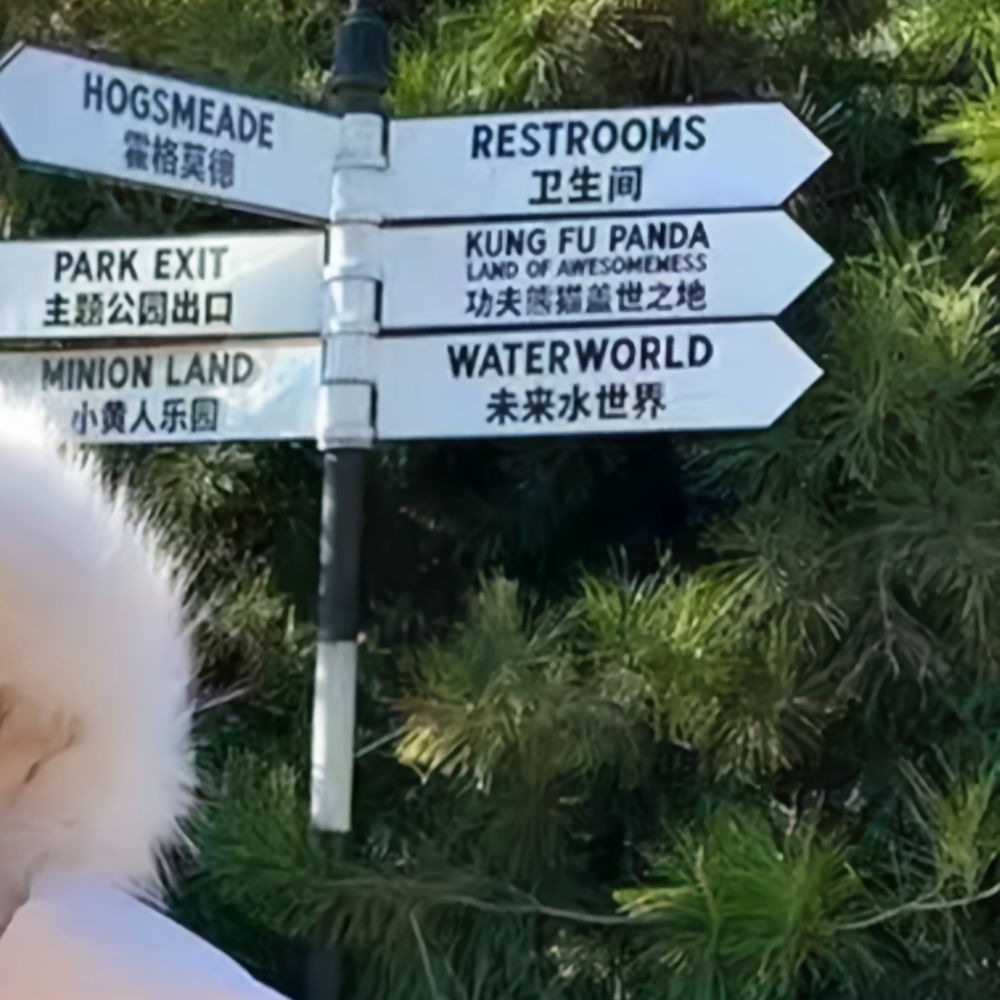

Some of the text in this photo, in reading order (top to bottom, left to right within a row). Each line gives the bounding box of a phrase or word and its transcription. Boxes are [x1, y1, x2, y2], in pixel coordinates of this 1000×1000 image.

[82, 71, 275, 150] HOGSMEADE
[470, 115, 706, 159] RESTROOMS
[528, 165, 643, 206] 卫生间
[466, 221, 710, 259] KUNG FU PANDA
[53, 246, 229, 283] PARK EXIT
[466, 253, 708, 282] LAND OF AWESOMENESS
[42, 290, 233, 328] 主题公园出口
[40, 351, 254, 391] MINION LAND
[446, 334, 714, 379] WATERWORLD
[71, 397, 220, 436] 小黄人乐园
[485, 382, 667, 425] 未来水世界
